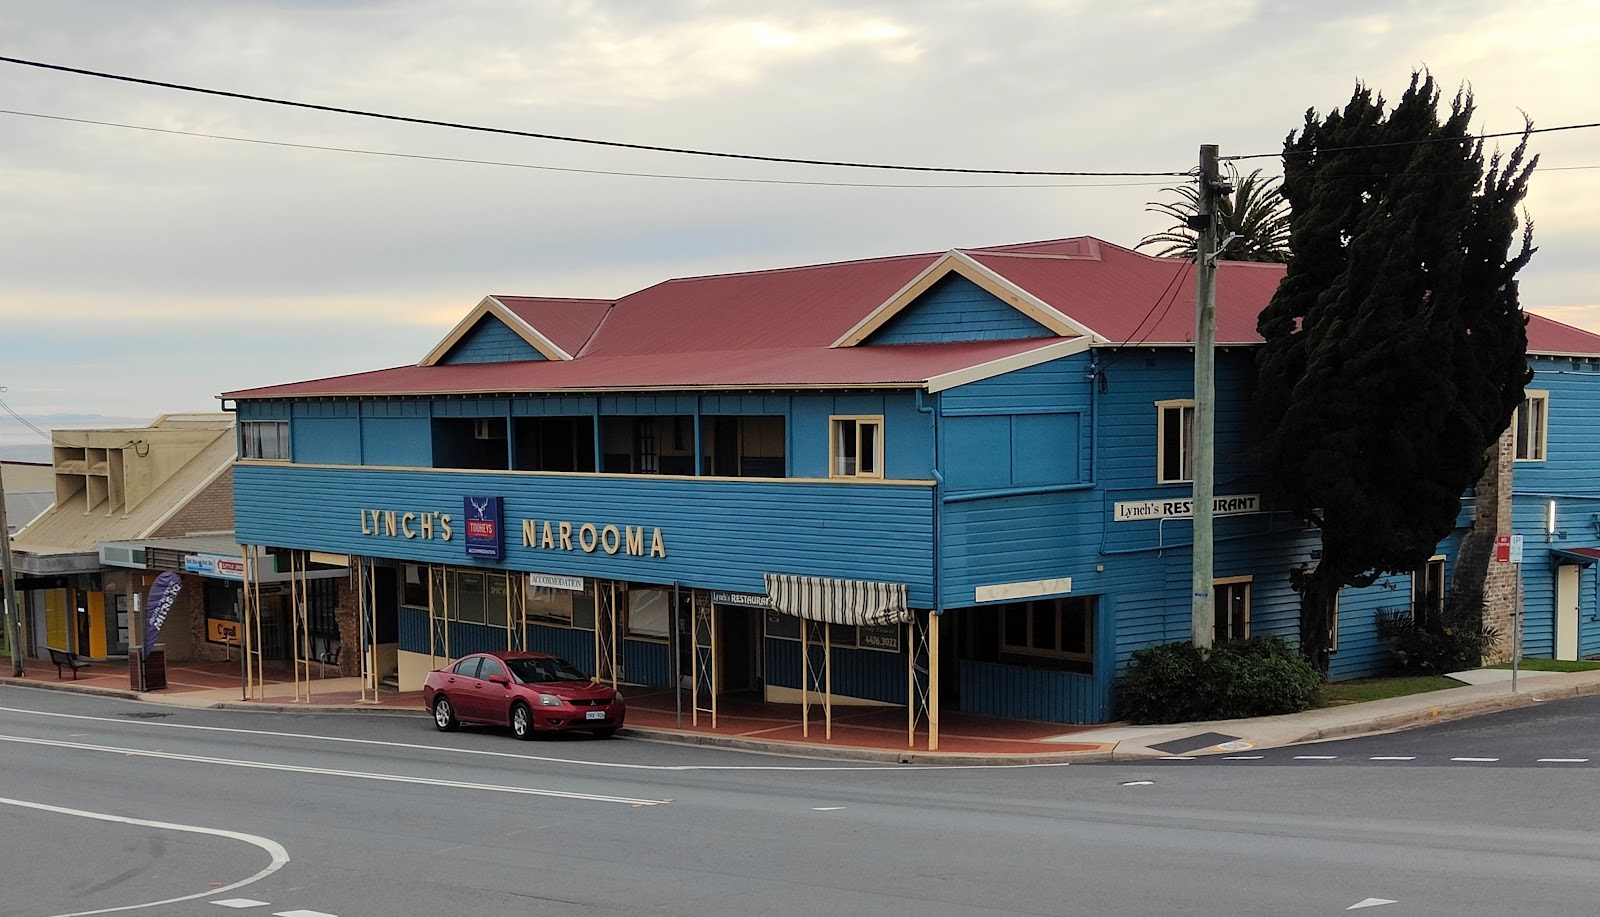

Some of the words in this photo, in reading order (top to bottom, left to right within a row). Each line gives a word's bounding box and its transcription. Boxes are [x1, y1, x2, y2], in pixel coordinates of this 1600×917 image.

[1120, 503, 1160, 518] Lynch's
[1163, 497, 1256, 515] RESRANT
[361, 509, 453, 541] LYNCH'S
[470, 522, 493, 534] TOOHEYS
[522, 520, 666, 558] NAROOMA
[531, 575, 582, 588] ACCOMMODATION
[731, 594, 772, 607] RESTAURA
[153, 596, 174, 631] MITRE
